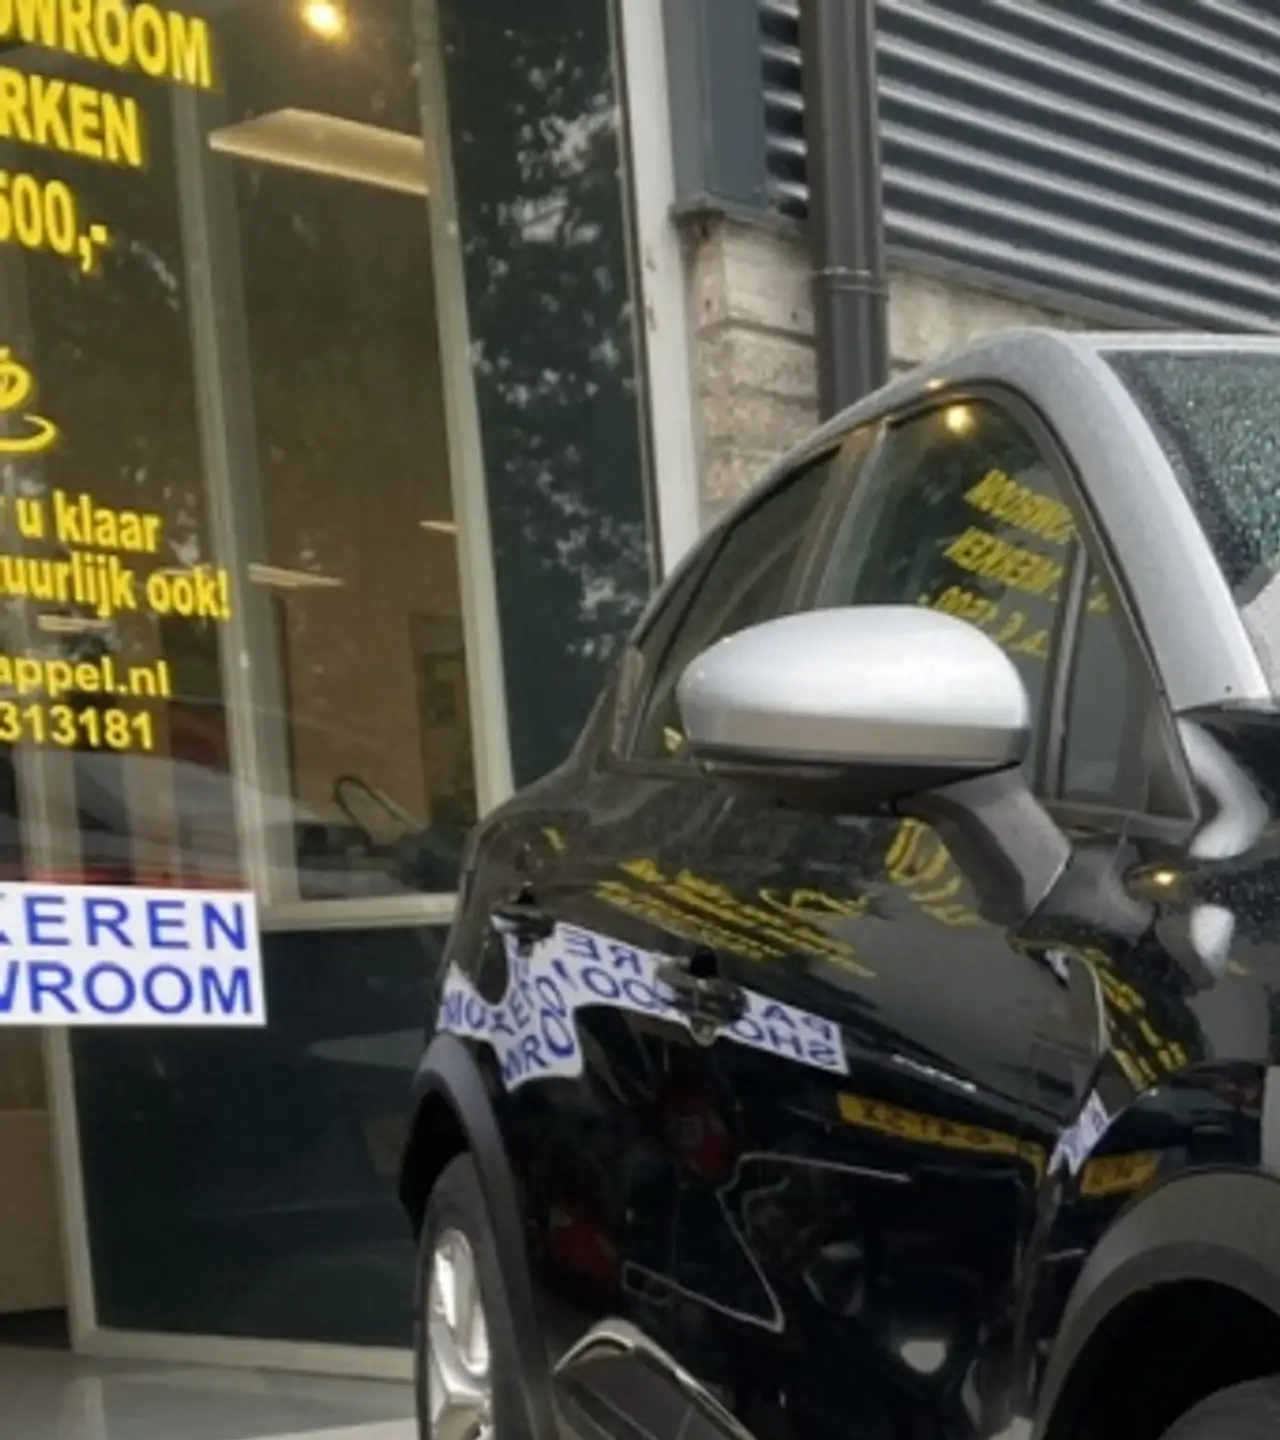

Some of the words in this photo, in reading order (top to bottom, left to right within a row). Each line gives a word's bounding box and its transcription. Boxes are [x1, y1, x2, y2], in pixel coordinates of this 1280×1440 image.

[0, 0, 211, 88] WROOM
[16, 498, 43, 538] u
[53, 489, 161, 552] klaar
[0, 553, 136, 617] uurlijk
[147, 565, 231, 621] ook!
[0, 893, 247, 950] EREN
